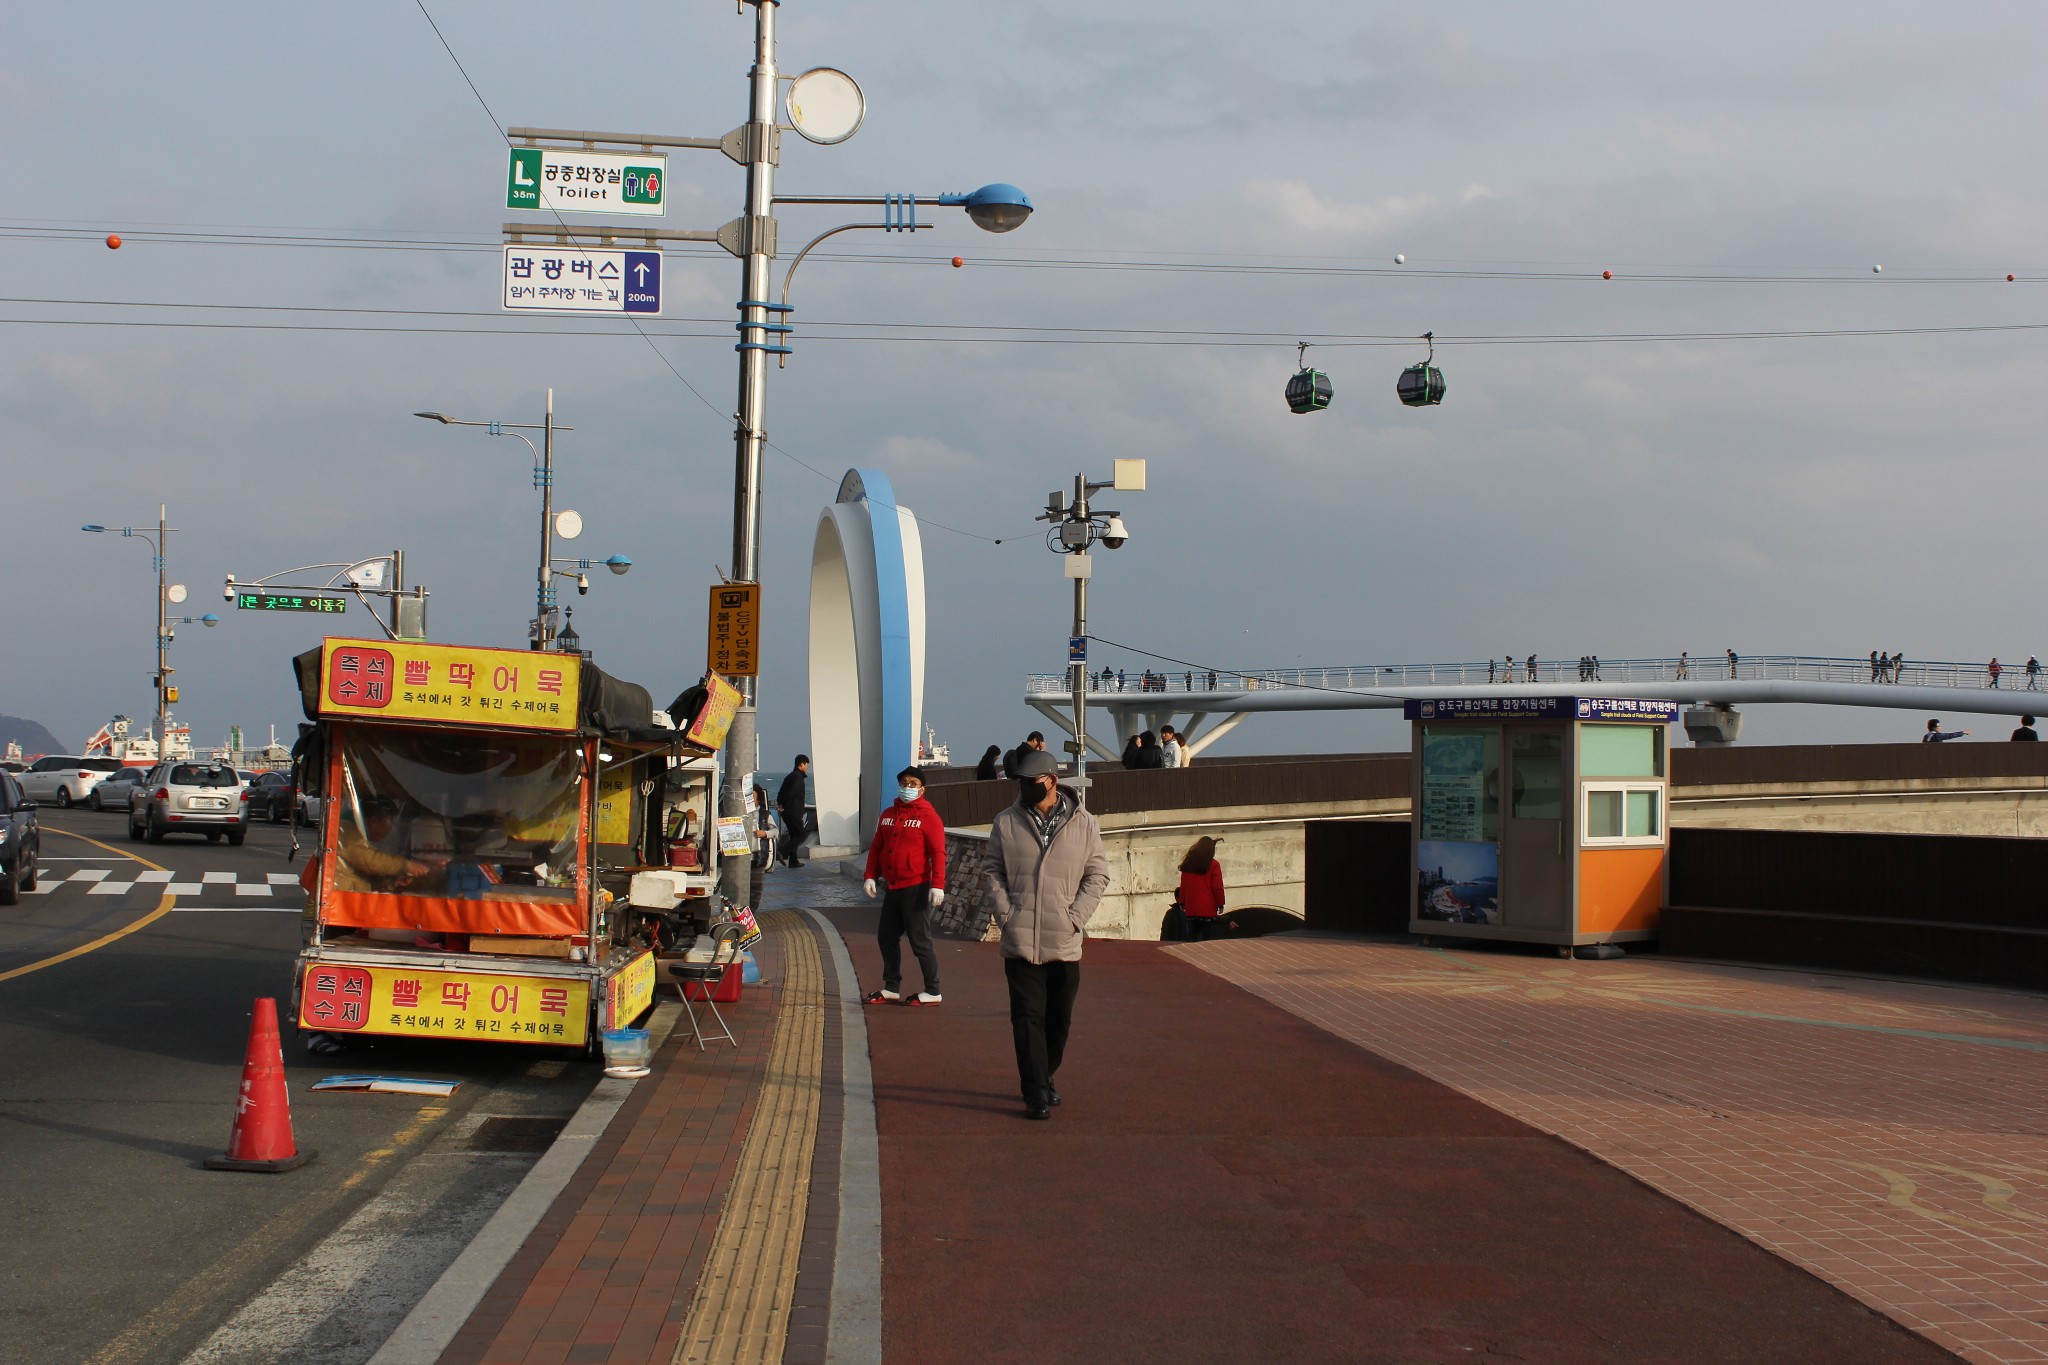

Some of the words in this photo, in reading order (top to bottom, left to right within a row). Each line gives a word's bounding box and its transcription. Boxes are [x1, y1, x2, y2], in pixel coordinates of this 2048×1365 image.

[544, 164, 621, 184] 공중화장실
[513, 190, 536, 199] 35m
[556, 186, 607, 199] Toilet
[510, 257, 620, 280] 관광버스
[510, 286, 535, 299] 임시
[538, 287, 576, 300] 주차장
[579, 289, 603, 301] 가는
[607, 289, 619, 301] 길
[628, 294, 656, 303] 200m
[264, 596, 303, 609] 곳으로
[341, 655, 385, 677] 즉석
[338, 679, 384, 701] 수제
[402, 692, 452, 706] 즉석에서
[460, 696, 471, 708] 갓
[480, 698, 503, 710] 튀긴
[511, 700, 560, 714] 수제어묵
[1502, 698, 1557, 710] 현장지원센터
[1591, 699, 1637, 711] 송도구름산책로
[1638, 700, 1677, 713] 현장지원센터
[599, 781, 623, 791] 어묵
[316, 974, 364, 997] 즉석
[314, 1000, 361, 1022] 수제
[390, 1014, 444, 1029] 즉석에서
[454, 1017, 467, 1030] 갓
[475, 1019, 501, 1033] 튀긴
[510, 1021, 565, 1036] 수제어묵
